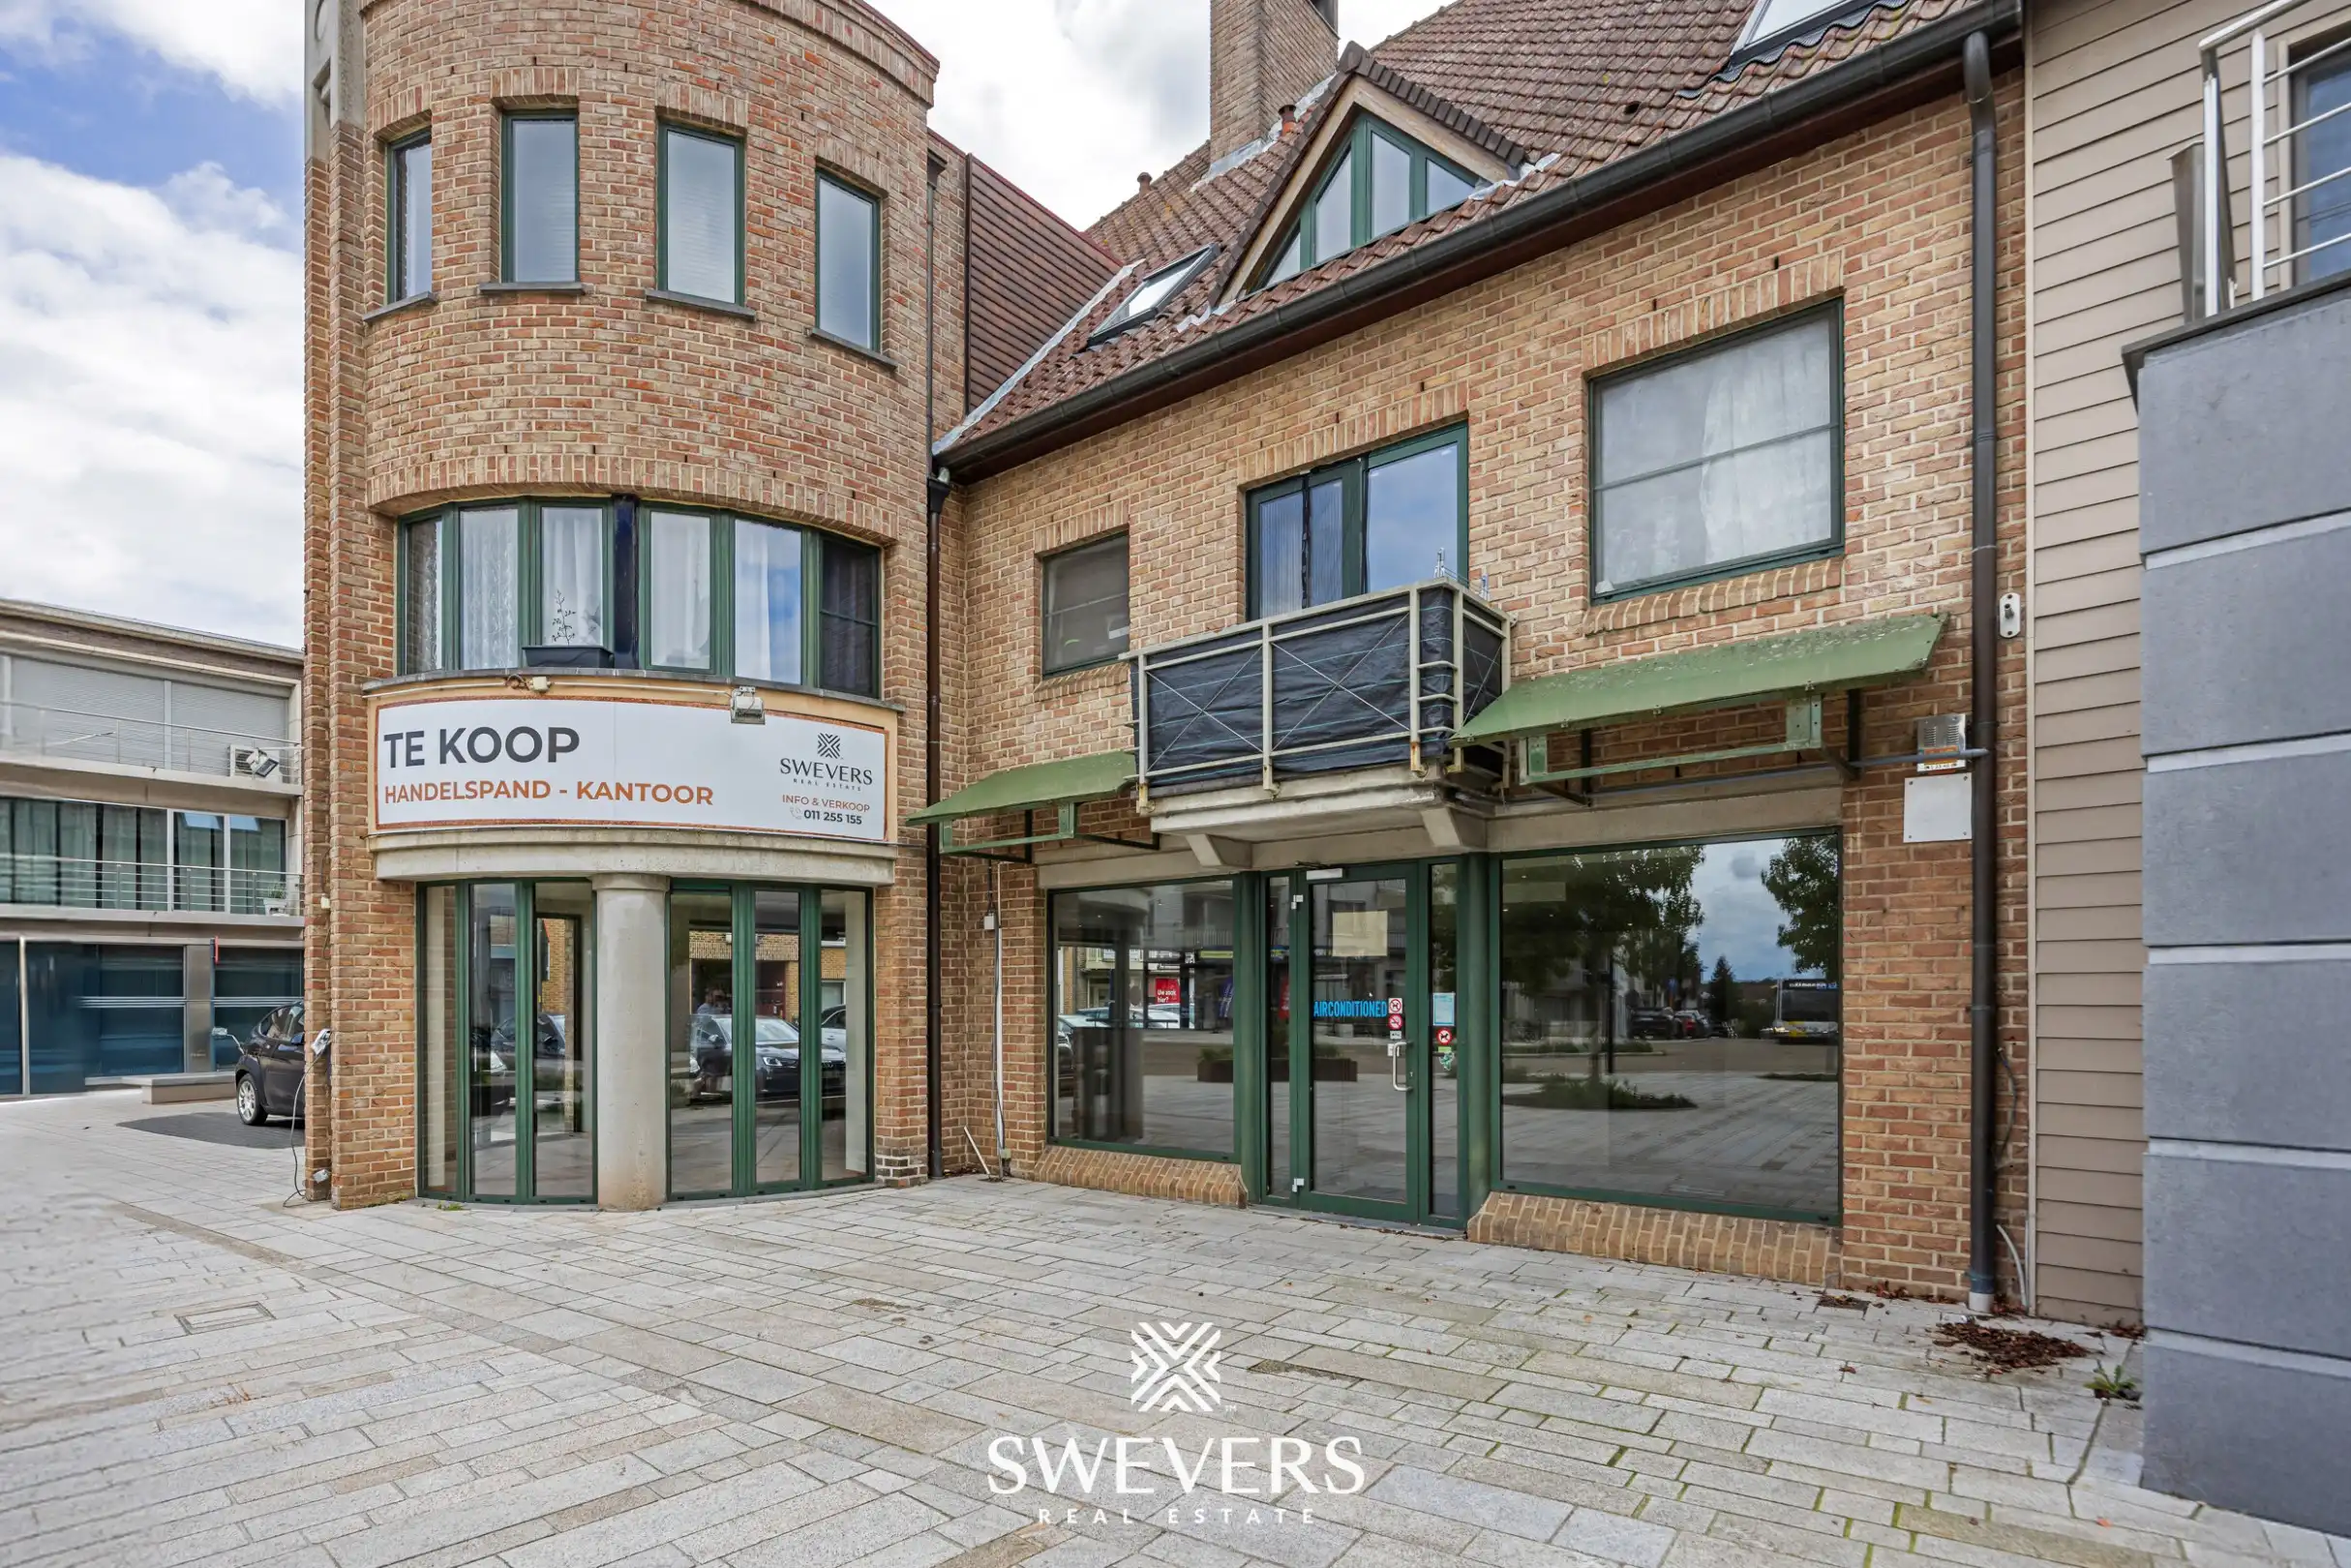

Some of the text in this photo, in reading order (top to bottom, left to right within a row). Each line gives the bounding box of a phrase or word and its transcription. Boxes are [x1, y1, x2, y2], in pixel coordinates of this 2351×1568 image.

[383, 726, 581, 769] TE KOOP
[779, 757, 873, 786] SWEVERS
[384, 780, 552, 804] HANDELSPAND
[577, 781, 714, 806] KANTOOR
[793, 777, 862, 792] REAL ESTATE
[782, 795, 870, 813] INFO & VERKOOP
[803, 809, 862, 825] 011 255 155
[1312, 1000, 1388, 1018] AIRCONDITIONED
